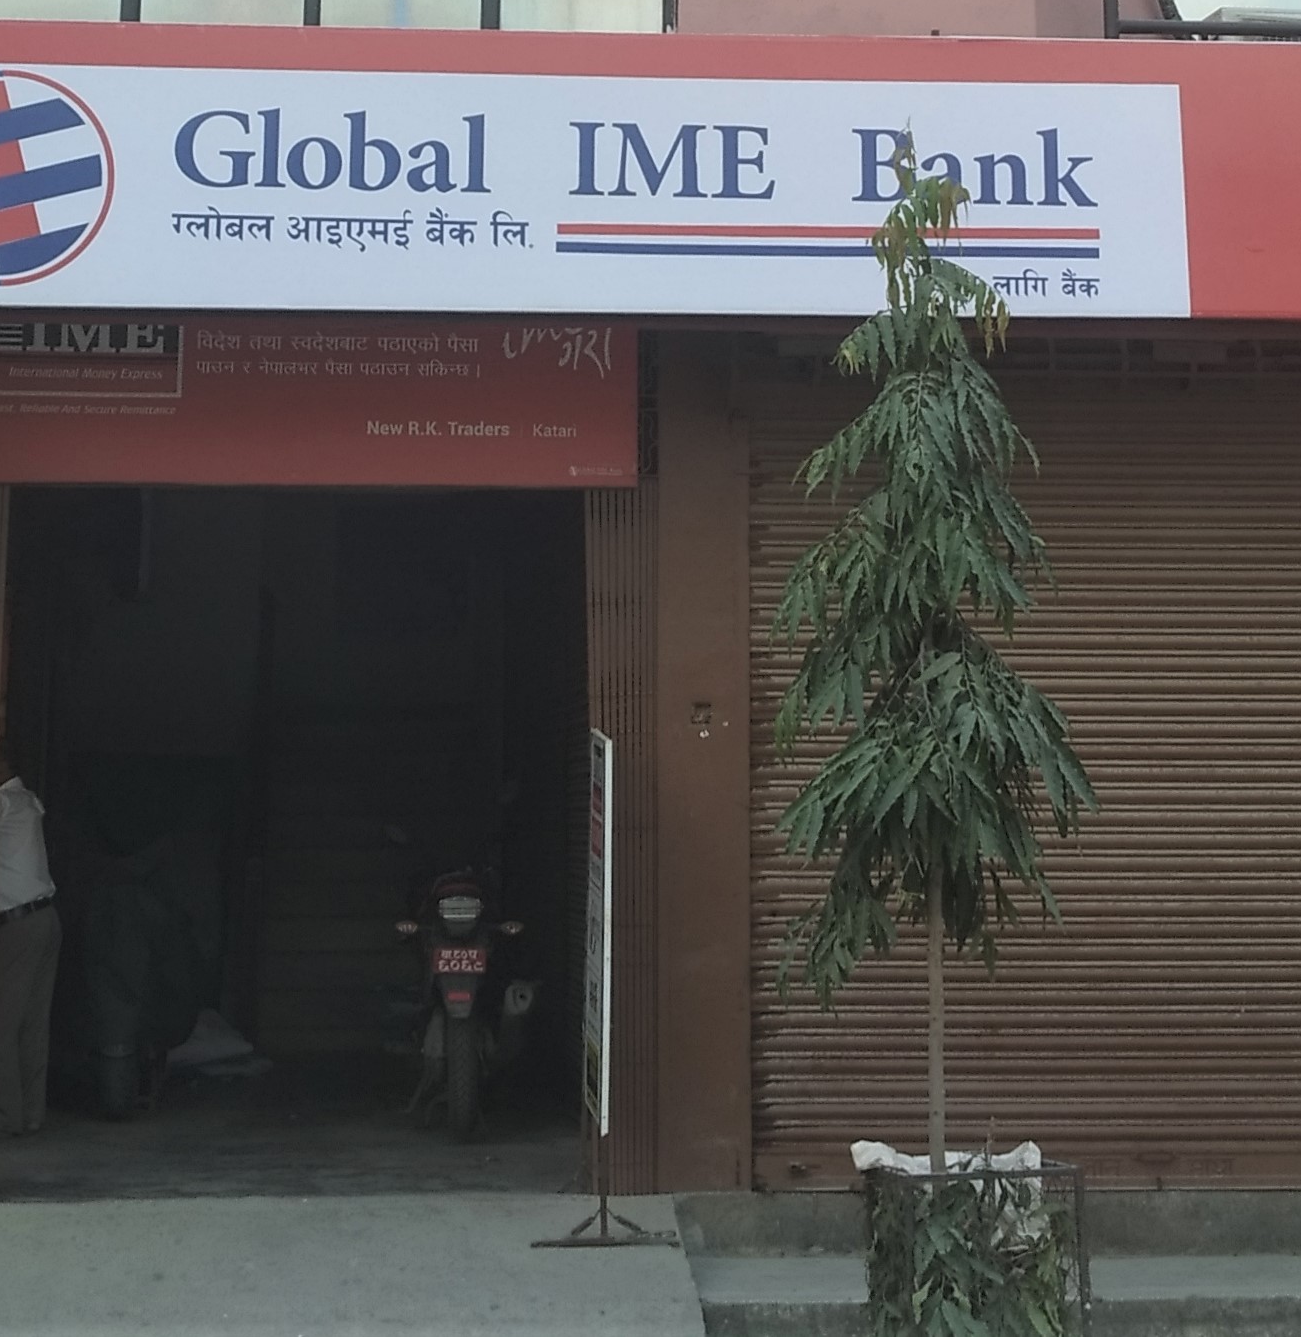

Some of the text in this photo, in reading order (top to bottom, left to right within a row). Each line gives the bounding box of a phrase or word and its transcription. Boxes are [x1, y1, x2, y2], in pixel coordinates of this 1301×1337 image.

[172, 107, 1099, 208] Global IME Bank
[170, 205, 274, 243] ग्लोबल
[285, 209, 414, 253] आइएमई
[424, 208, 478, 247] बैंक
[992, 267, 1100, 299] लागि बैंक
[26, 322, 166, 354] IME
[196, 329, 479, 355] विदेश तथा स्वदेशबाट पठाएको पैसा
[8, 366, 164, 381] International Money Express
[325, 357, 353, 377] पैसा
[359, 360, 411, 378] पठाउन
[366, 420, 578, 439] New R.K. Traders Katari
